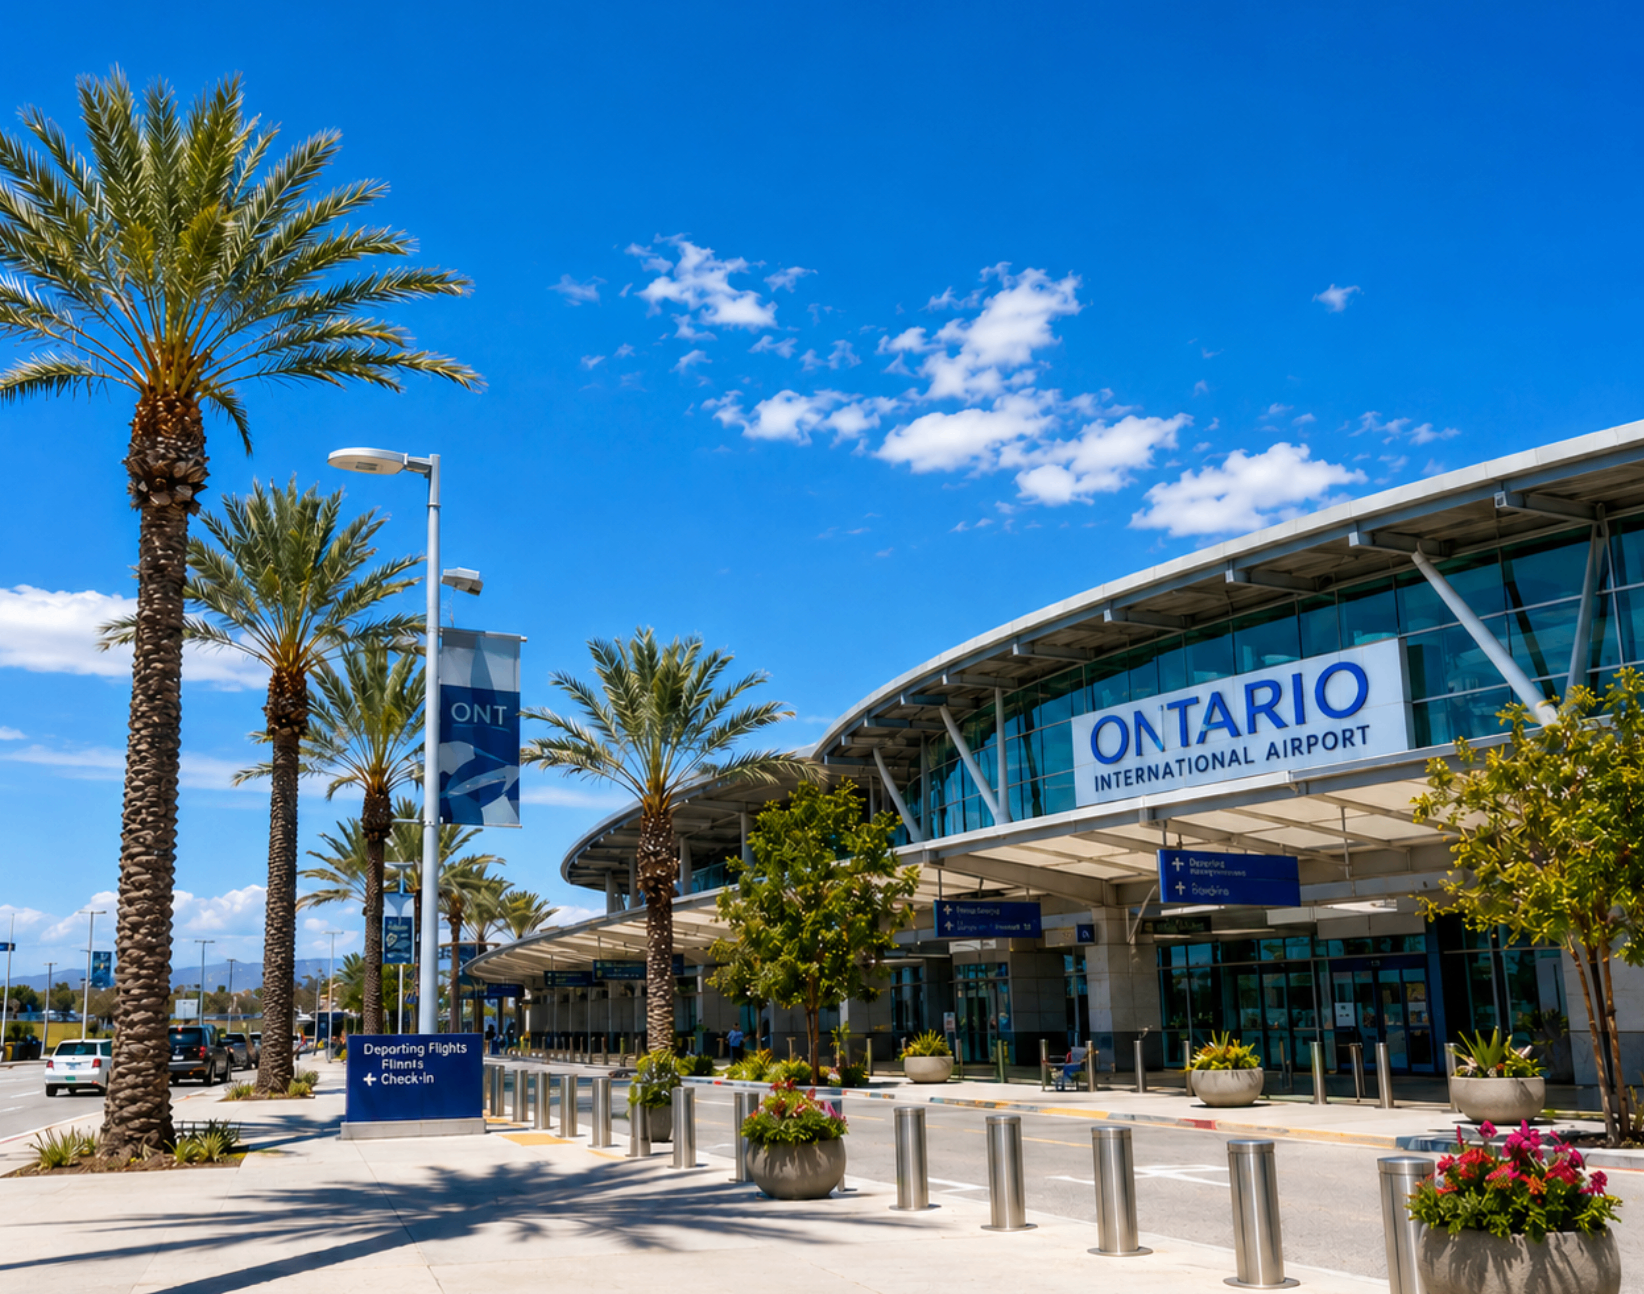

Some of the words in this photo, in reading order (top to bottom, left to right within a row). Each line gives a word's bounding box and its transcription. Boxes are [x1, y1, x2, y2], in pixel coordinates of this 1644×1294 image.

[451, 702, 507, 725] ONT
[1090, 661, 1369, 765] ONTARIO
[1094, 747, 1255, 792] INTERNATIONAL
[1265, 725, 1370, 761] AIRPORT
[428, 1042, 468, 1057] Flights
